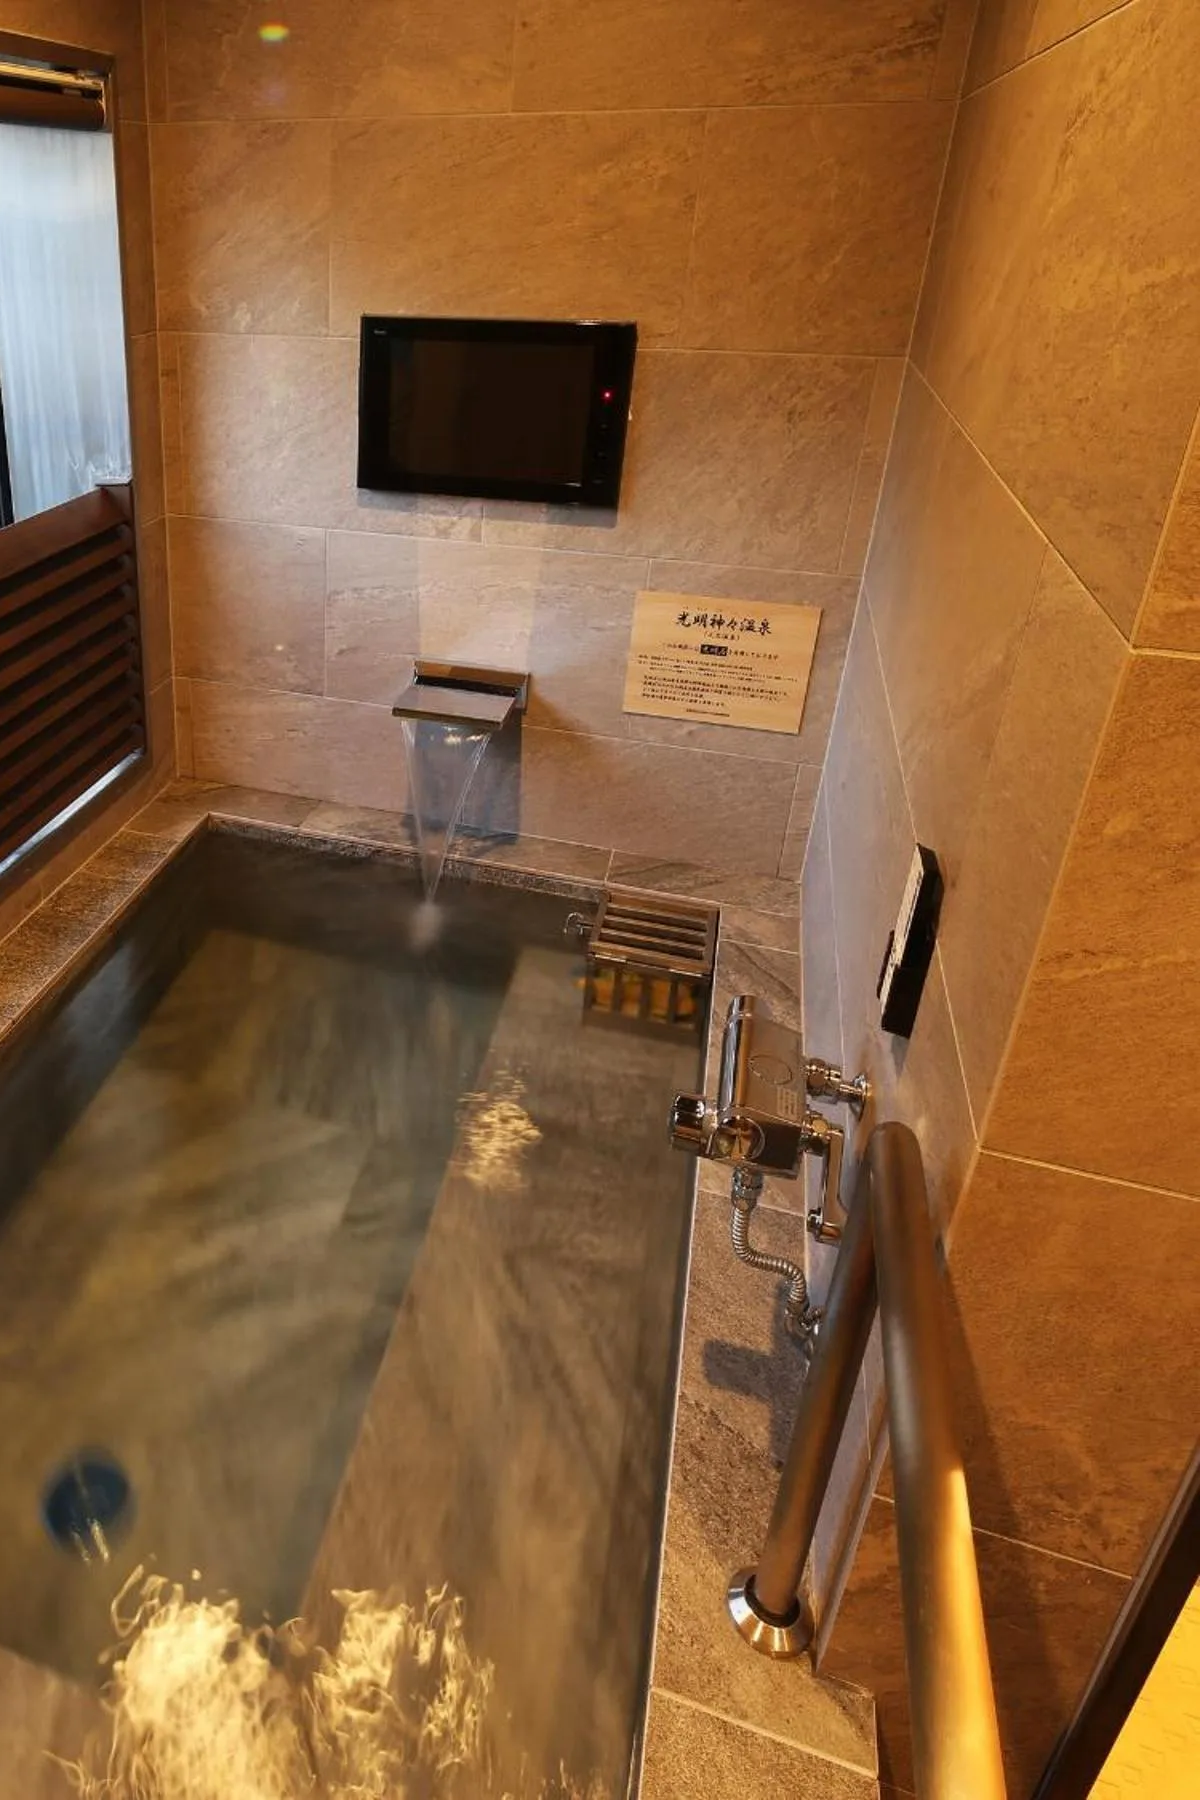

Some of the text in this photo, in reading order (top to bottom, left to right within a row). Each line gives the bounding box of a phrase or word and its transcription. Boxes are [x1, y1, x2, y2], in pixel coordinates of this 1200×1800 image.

[676, 611, 772, 636] 光明神々温泉
